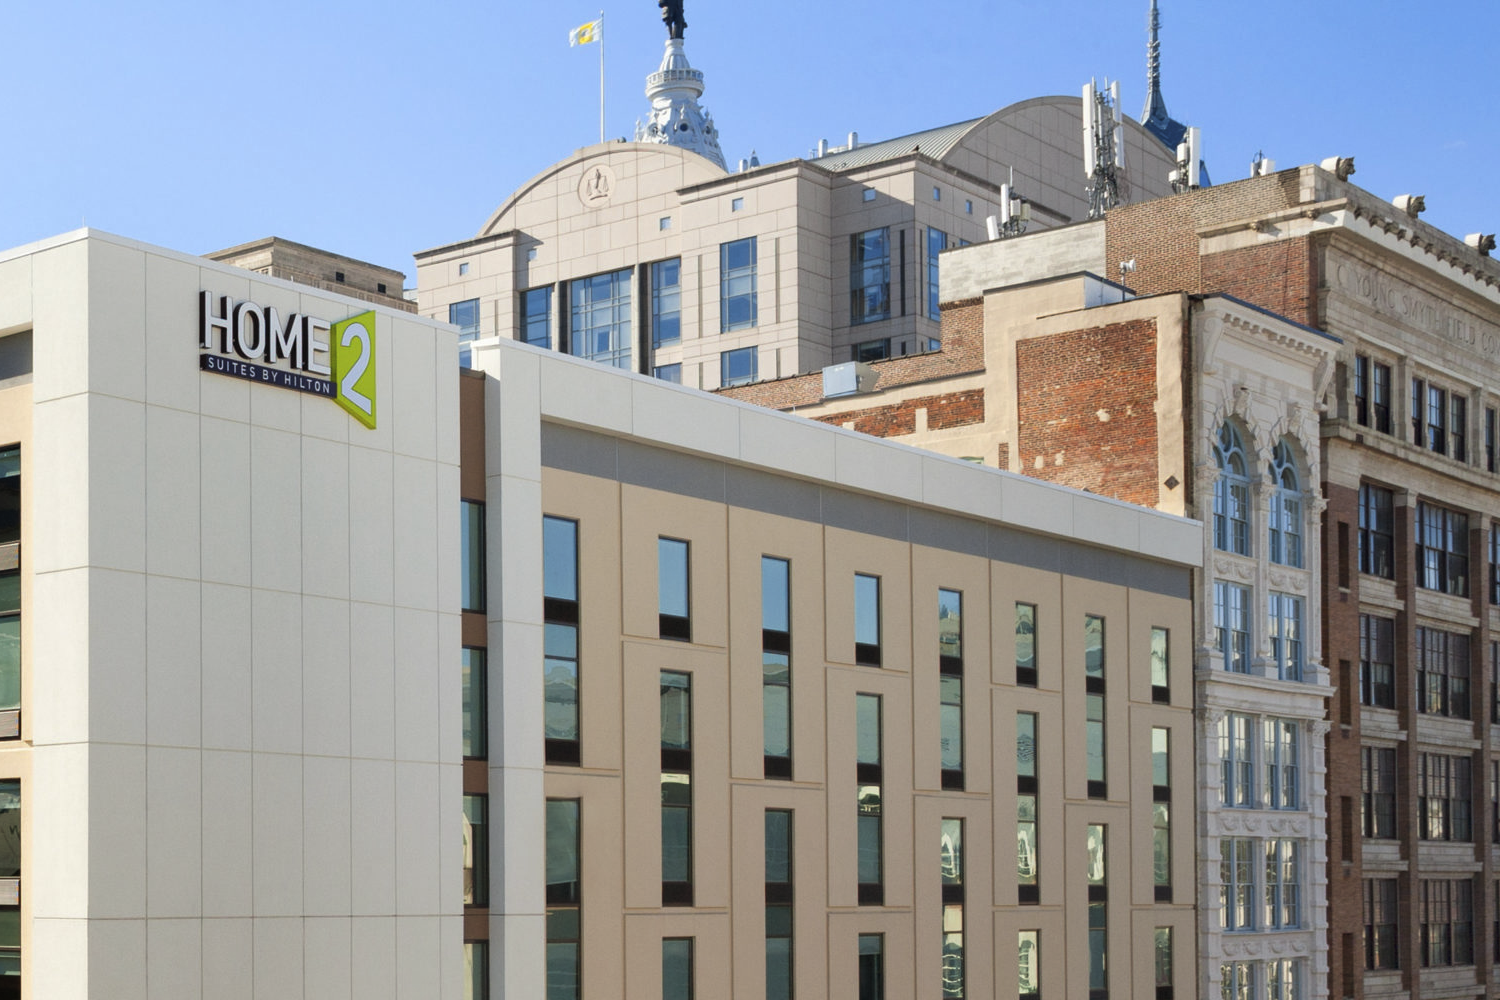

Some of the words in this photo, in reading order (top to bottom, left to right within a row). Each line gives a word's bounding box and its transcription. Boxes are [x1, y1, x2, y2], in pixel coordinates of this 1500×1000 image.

[200, 290, 331, 376] HOME
[340, 322, 372, 416] 2
[208, 356, 256, 378] SUITES
[262, 369, 279, 386] BY
[284, 374, 331, 395] HILTON
